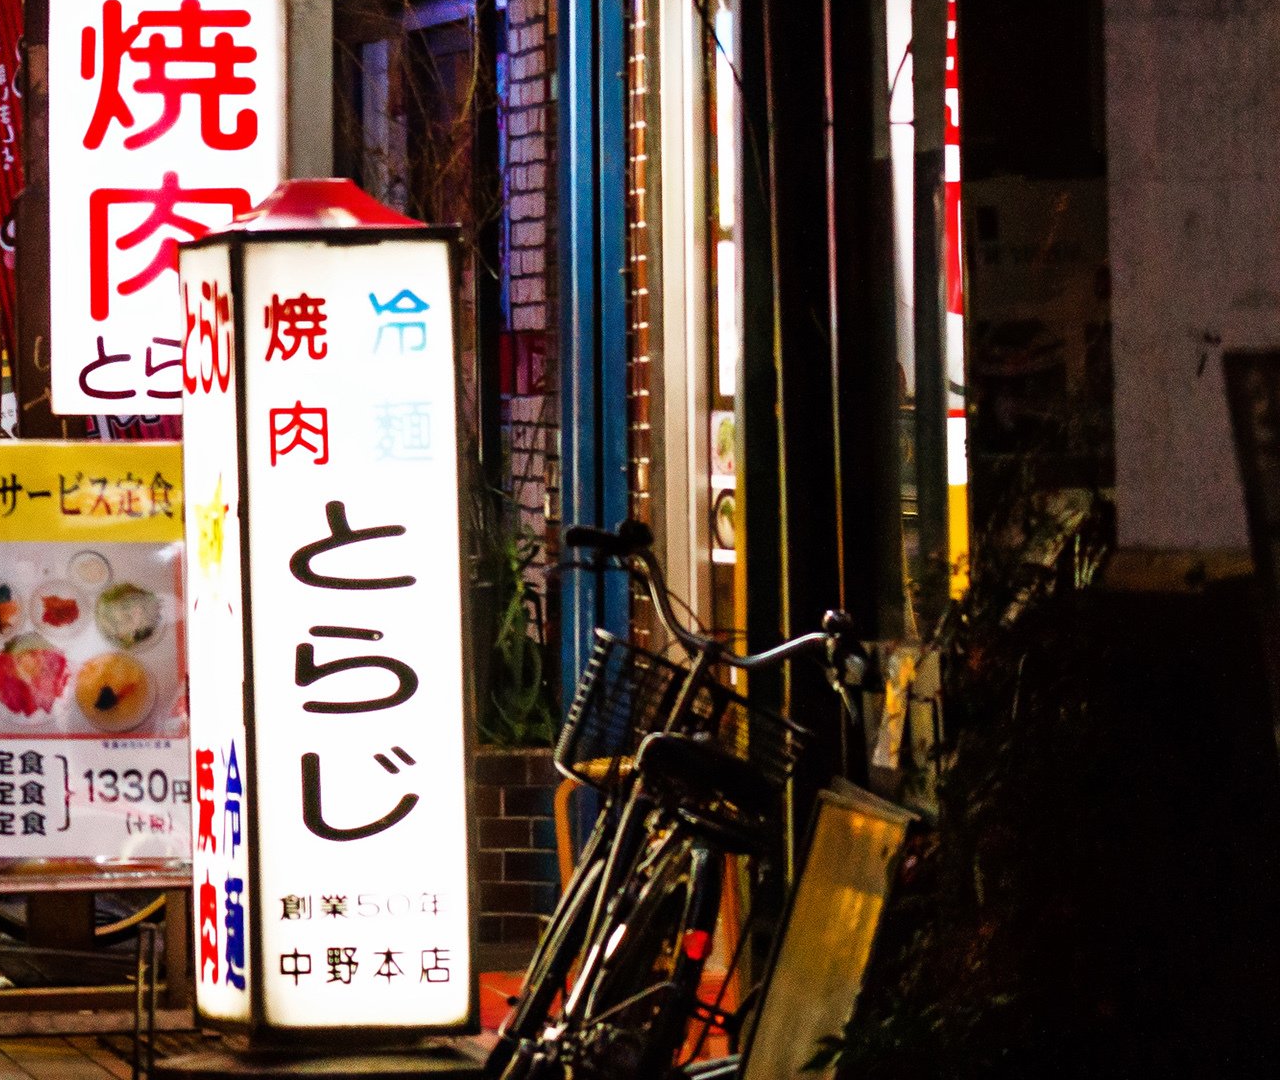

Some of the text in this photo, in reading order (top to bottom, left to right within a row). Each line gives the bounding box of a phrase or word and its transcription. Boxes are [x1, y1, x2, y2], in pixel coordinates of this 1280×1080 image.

[78, 335, 182, 401] とら
[181, 280, 231, 395] とらじ
[263, 291, 331, 467] 焼肉
[288, 500, 421, 843] とらじ
[83, 768, 191, 805] 1330円
[278, 891, 448, 921] 創業50年
[278, 946, 451, 987] 中野本店
